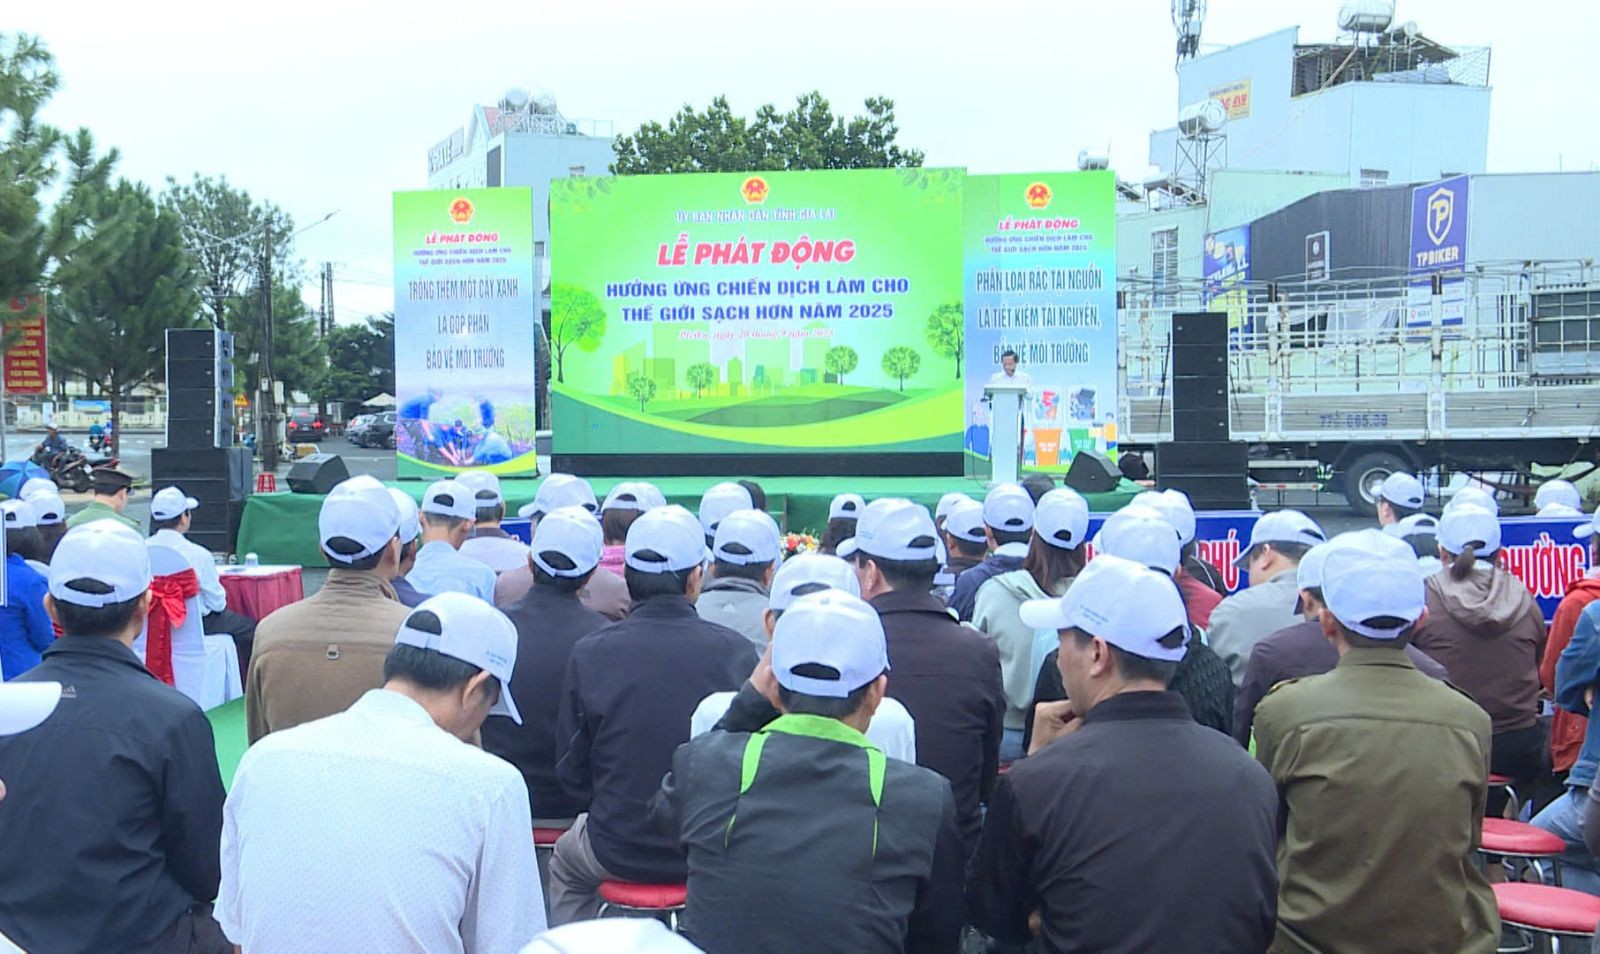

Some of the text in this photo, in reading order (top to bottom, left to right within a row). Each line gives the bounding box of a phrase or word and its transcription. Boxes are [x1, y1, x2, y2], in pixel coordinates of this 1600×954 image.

[657, 233, 855, 270] LỄ PHÁT ĐỘNG
[460, 275, 477, 303] MỘT
[496, 277, 518, 298] XANH
[673, 279, 710, 296] ỨNG
[717, 276, 771, 295] CHIẾN
[777, 279, 820, 298] DỊCH
[826, 277, 865, 294] LÀM
[872, 278, 908, 293] CHO
[977, 267, 1002, 291] PHÂN
[1005, 271, 1026, 297] LOẠI
[1029, 267, 1048, 290] RÁC
[1051, 269, 1066, 296] TẠI
[622, 302, 893, 323] THẾ GIỚI SẠCH HƠN NĂM 2025
[1014, 303, 1039, 333] KIỆM
